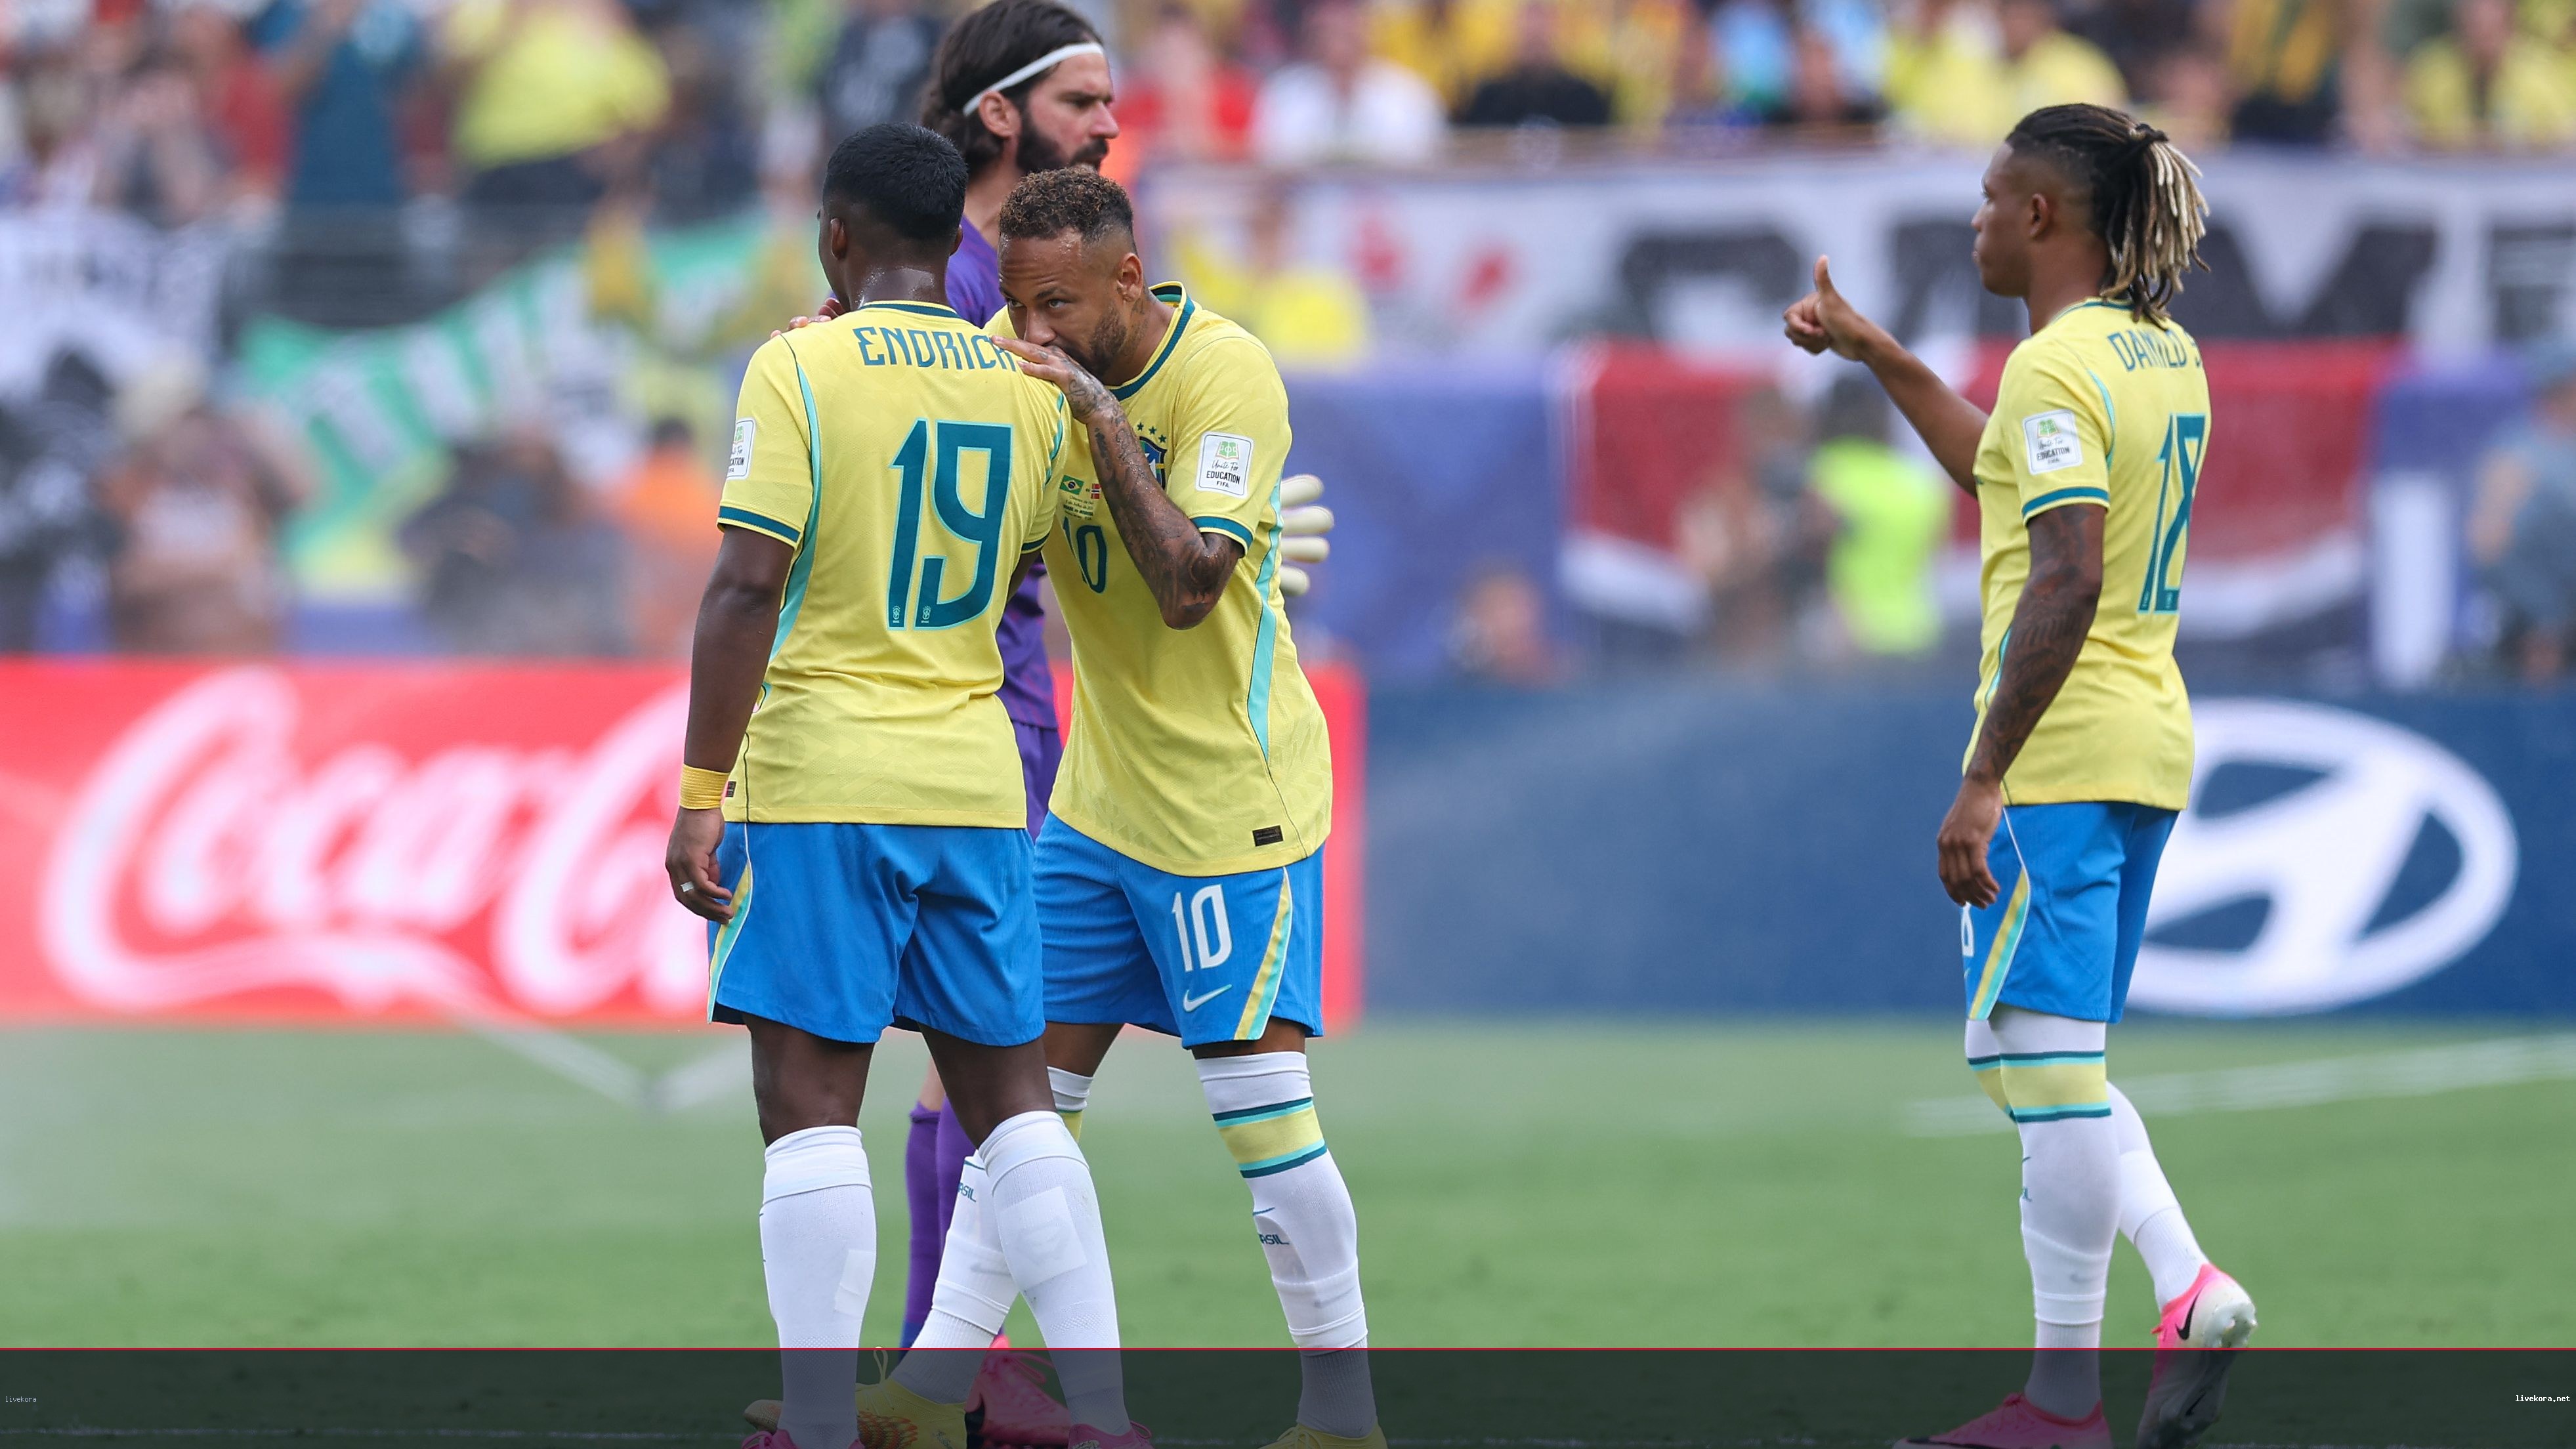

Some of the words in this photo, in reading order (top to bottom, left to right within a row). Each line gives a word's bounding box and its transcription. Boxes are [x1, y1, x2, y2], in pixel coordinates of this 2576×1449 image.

[1206, 471, 1240, 484] EDUCATION
[1212, 459, 1229, 469] Unite
[886, 417, 1013, 631] 19
[2137, 413, 2206, 614] 18
[1172, 883, 1233, 973] 10
